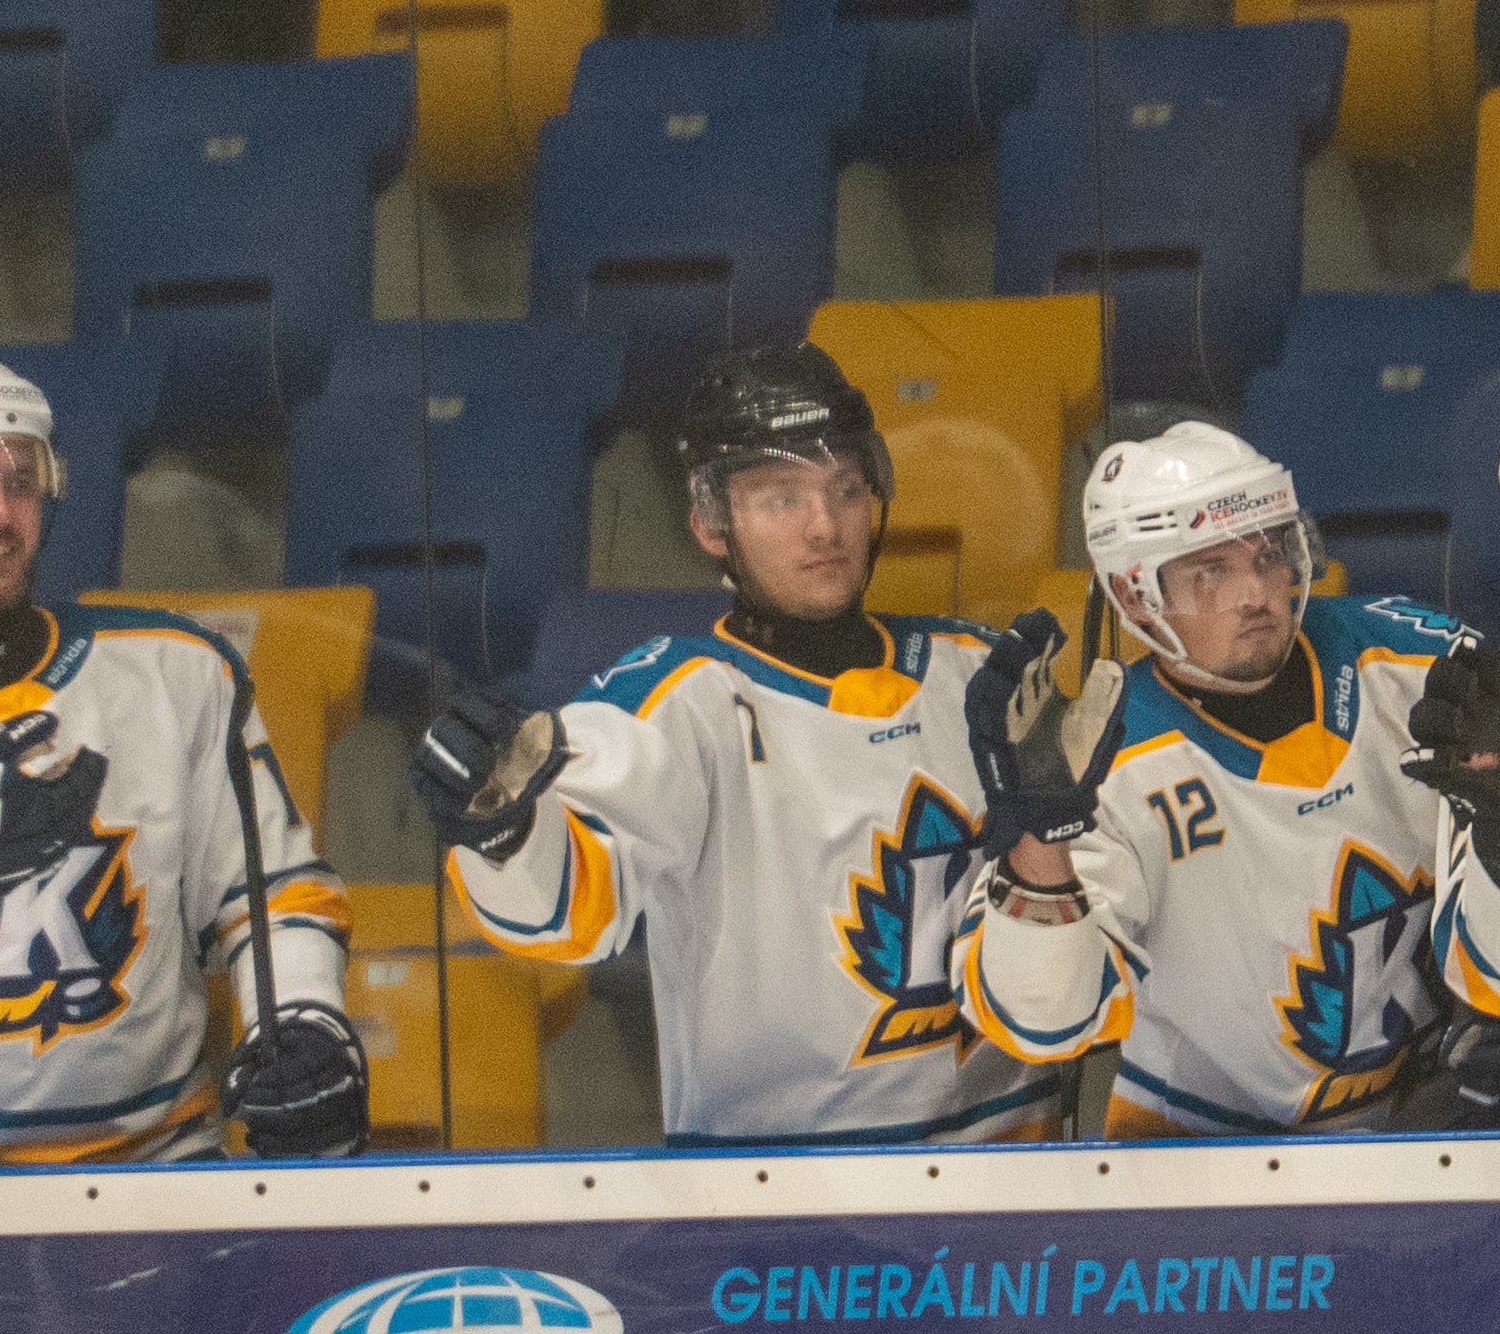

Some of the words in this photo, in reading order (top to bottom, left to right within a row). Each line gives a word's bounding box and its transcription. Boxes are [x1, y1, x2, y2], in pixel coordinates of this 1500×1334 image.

[770, 406, 831, 429] BAUER
[868, 721, 922, 744] CCM
[1297, 782, 1355, 816] CCM
[1147, 776, 1226, 862] 12
[712, 1245, 1058, 1324] GENERÁLNÍ
[1071, 1254, 1335, 1313] PARTNER
